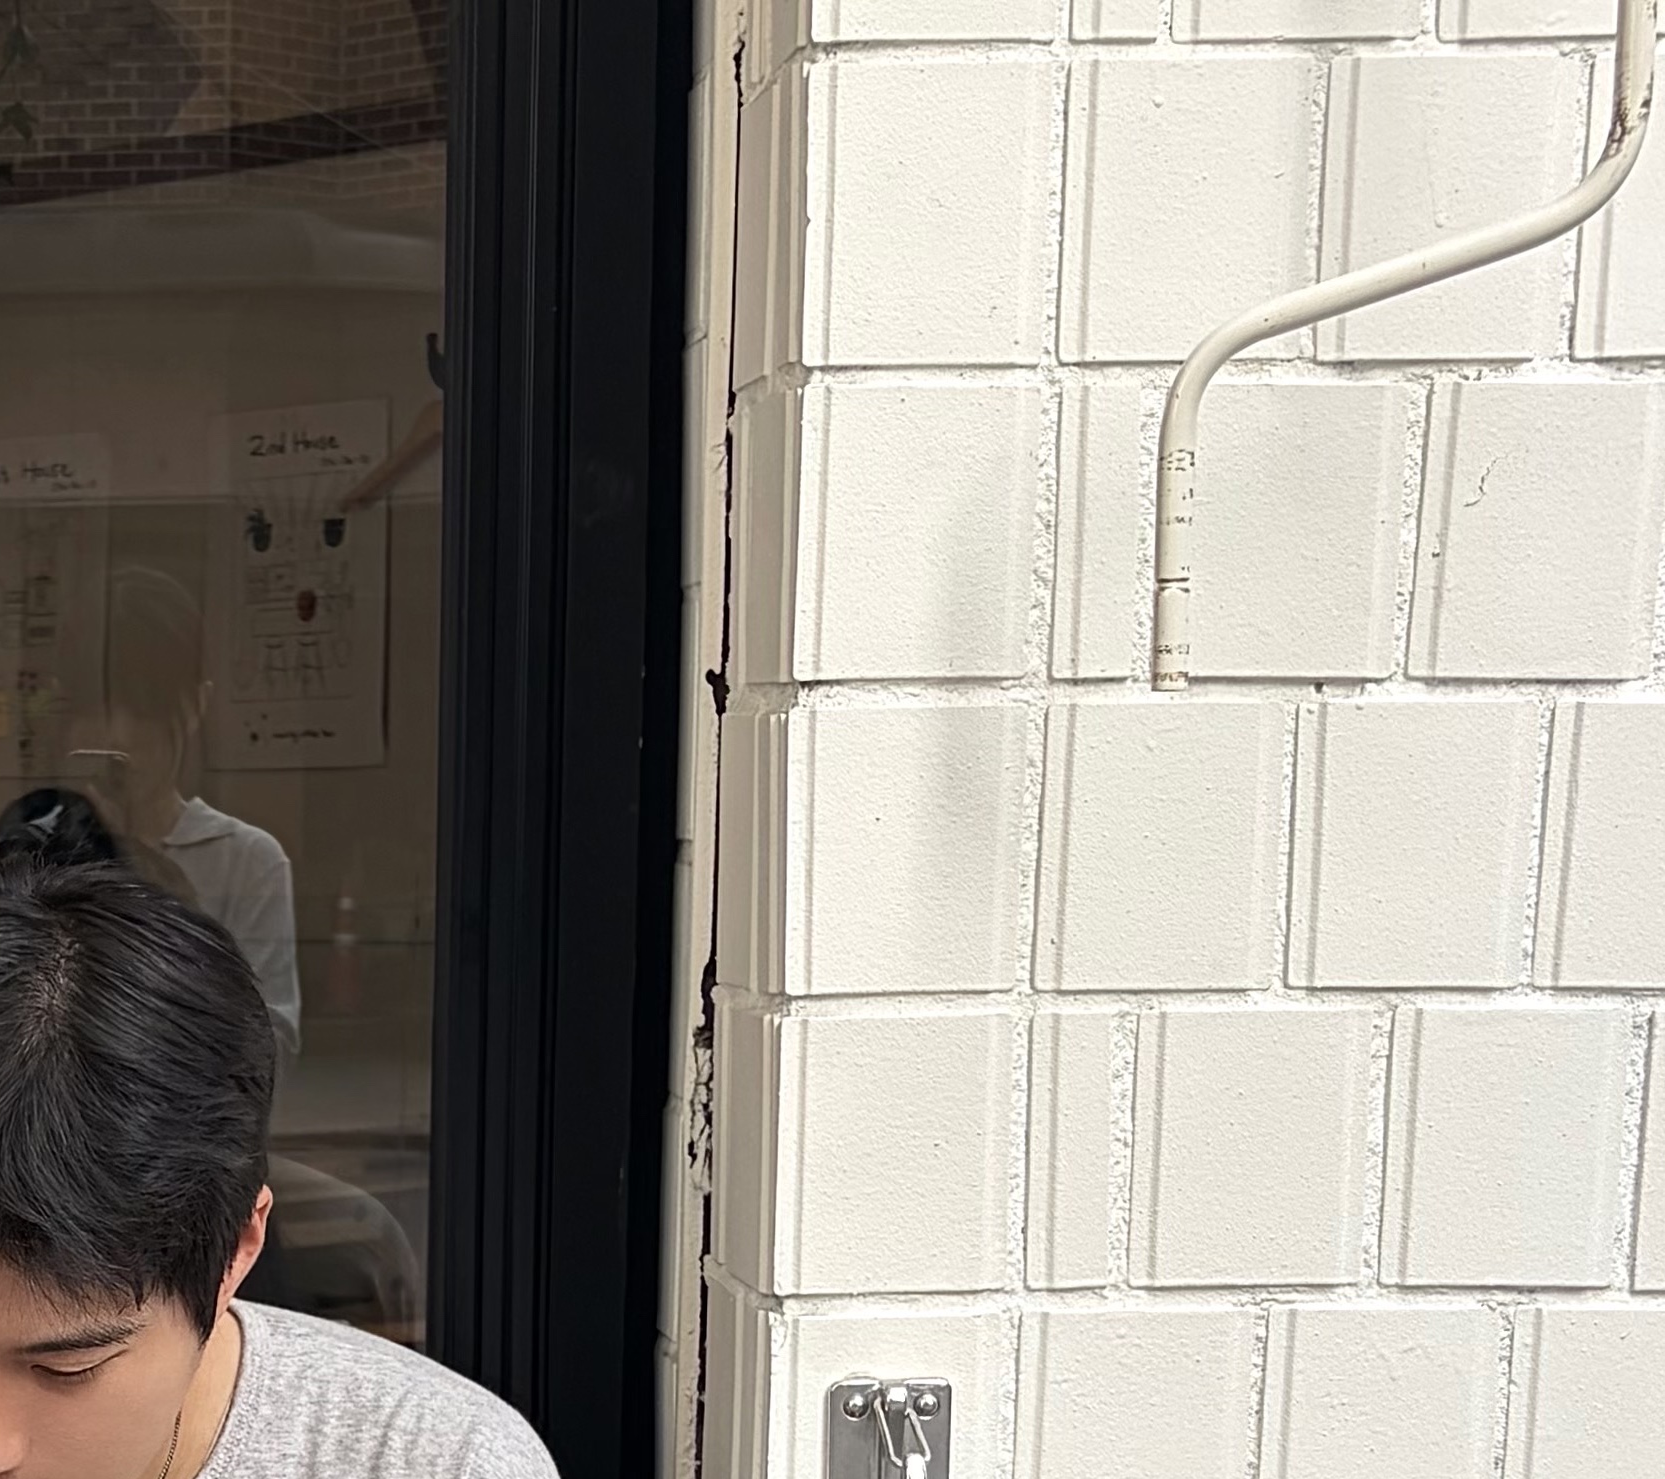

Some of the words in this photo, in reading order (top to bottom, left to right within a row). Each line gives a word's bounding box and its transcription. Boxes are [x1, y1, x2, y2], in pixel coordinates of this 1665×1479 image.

[248, 431, 286, 457] 2nd
[292, 430, 339, 453] House
[21, 460, 75, 482] House
